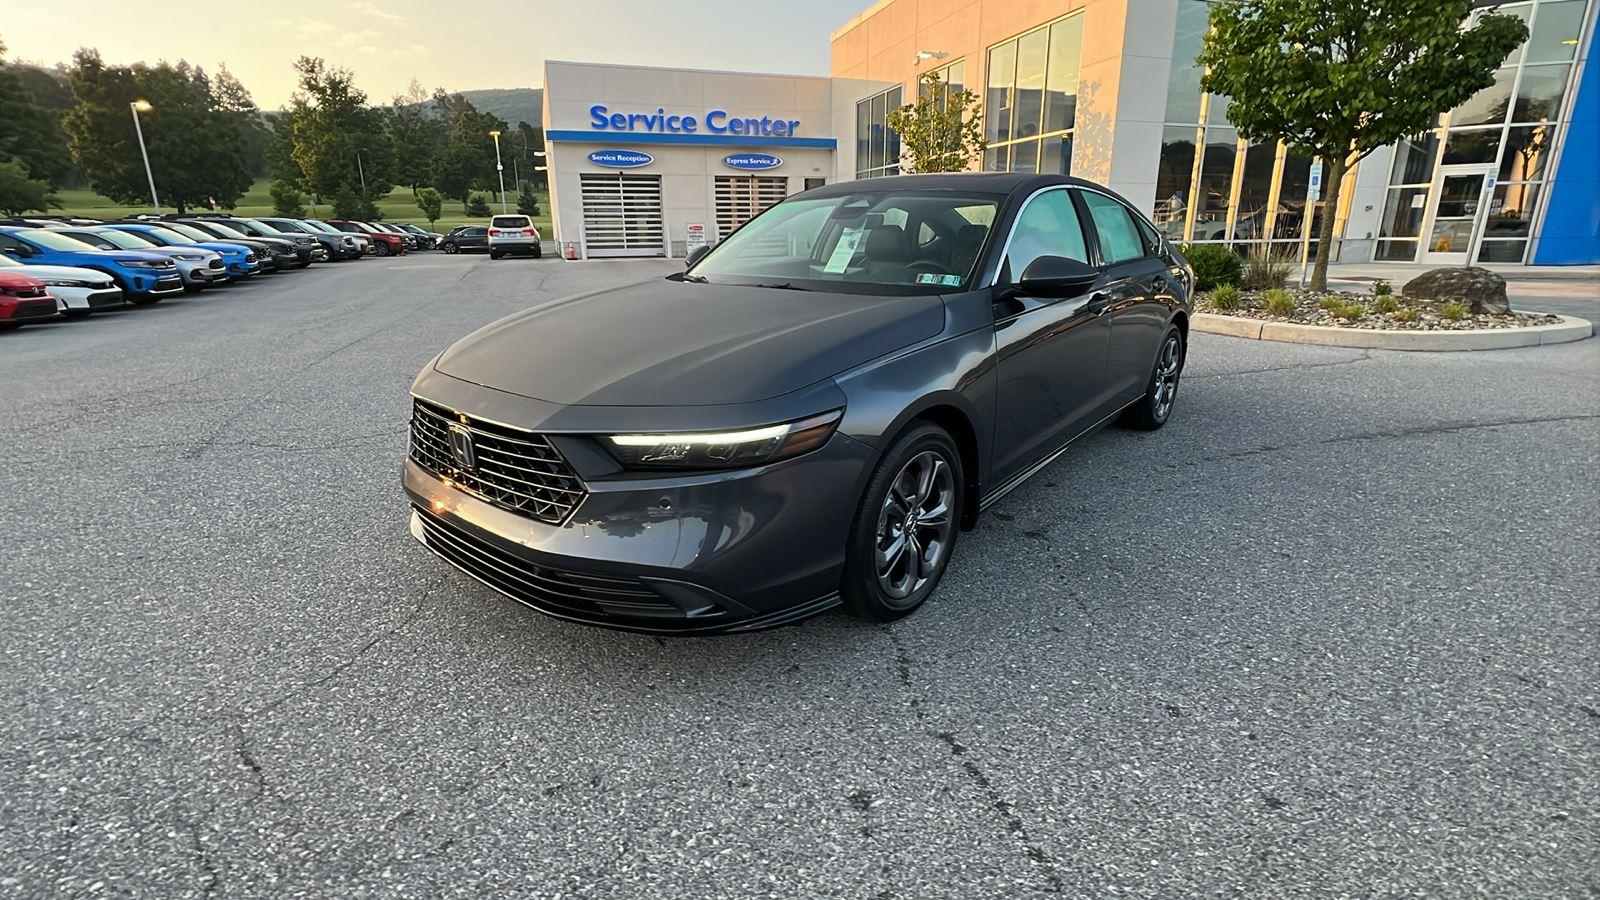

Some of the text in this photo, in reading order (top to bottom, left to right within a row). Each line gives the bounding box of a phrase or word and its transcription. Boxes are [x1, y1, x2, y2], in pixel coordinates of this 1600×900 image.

[590, 105, 800, 136] Service Center
[617, 155, 650, 163] Reception
[726, 157, 748, 165] Express
